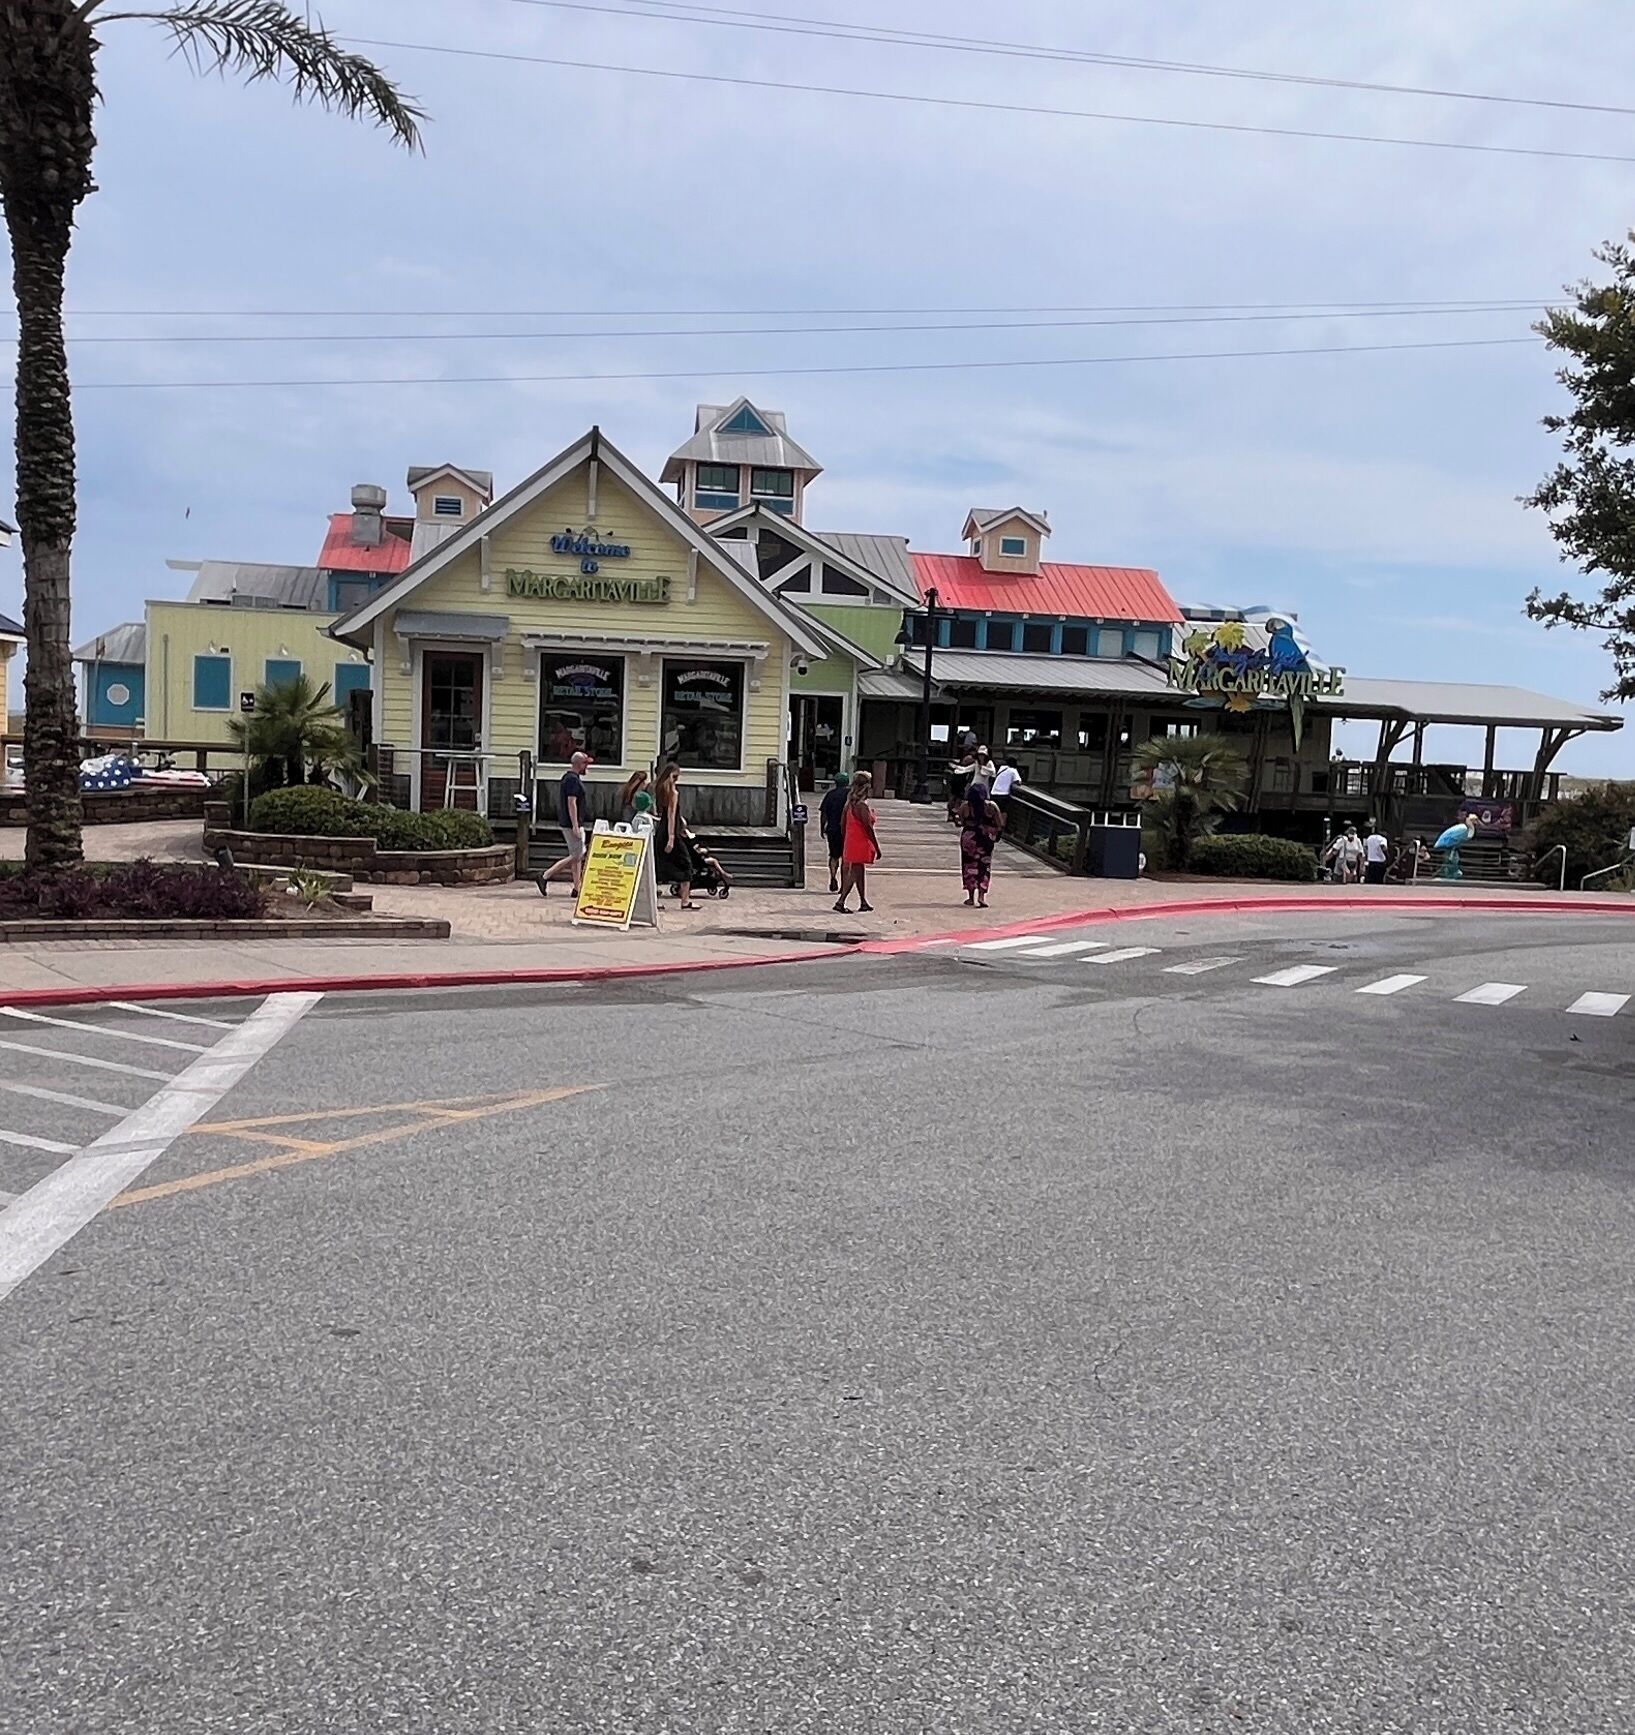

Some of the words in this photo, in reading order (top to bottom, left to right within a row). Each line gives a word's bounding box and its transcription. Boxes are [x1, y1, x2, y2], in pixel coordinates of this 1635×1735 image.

[550, 535, 631, 557] Welcome
[580, 559, 599, 574] to
[506, 568, 672, 605] MARGARITAVILLE
